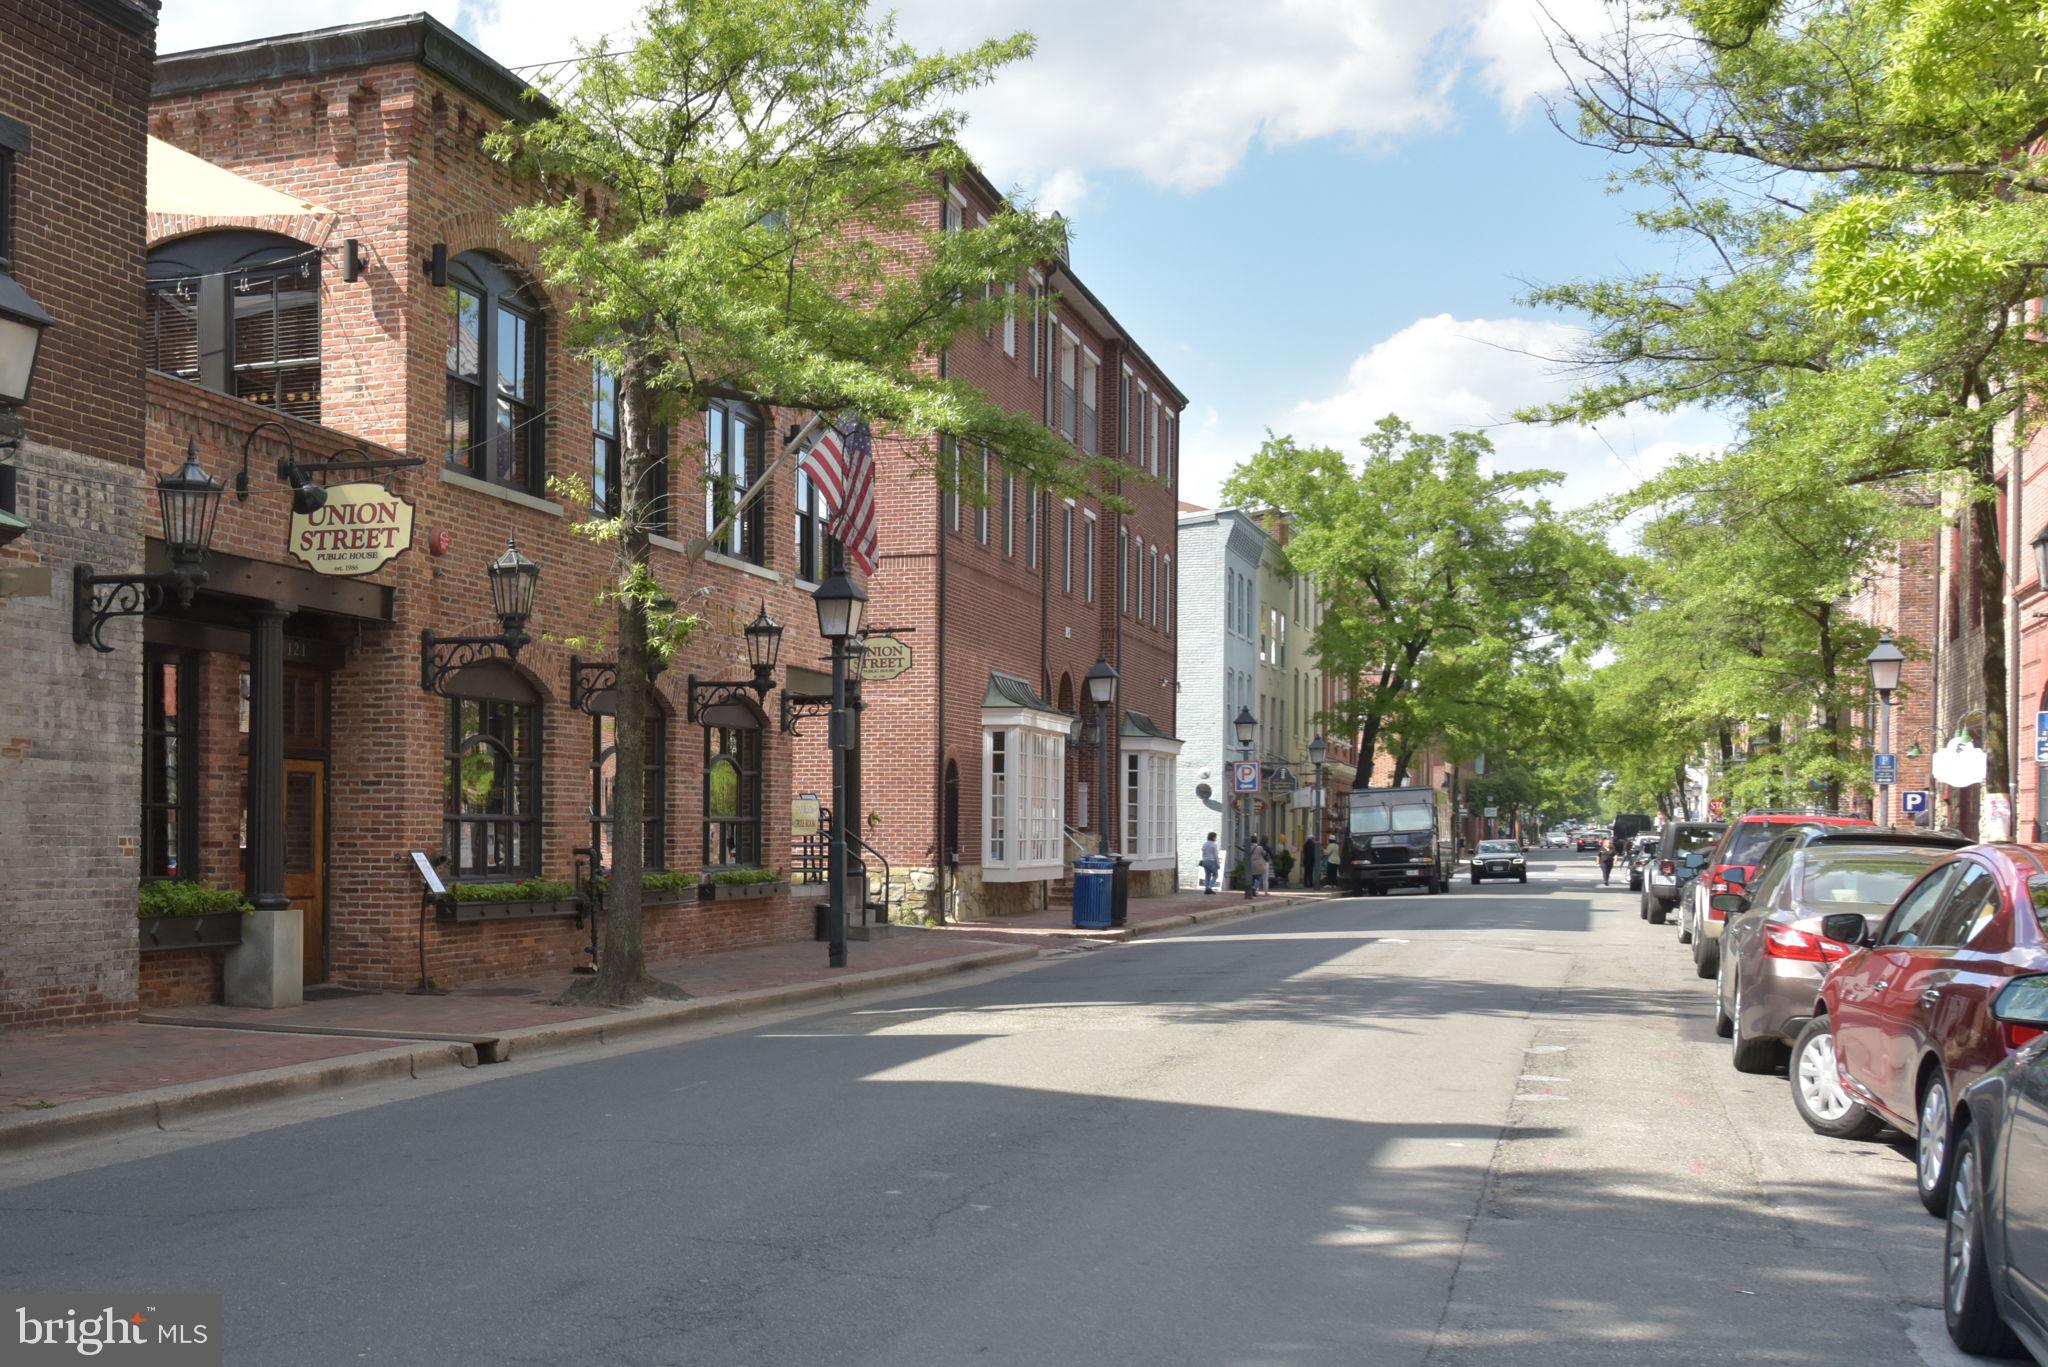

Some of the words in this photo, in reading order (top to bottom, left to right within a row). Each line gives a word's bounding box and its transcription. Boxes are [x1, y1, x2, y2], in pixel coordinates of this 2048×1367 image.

[308, 502, 399, 526] UNION
[300, 527, 400, 551] STREET
[317, 552, 348, 561] PUBLIC
[349, 551, 378, 560] HOUSE
[864, 645, 903, 657] NION
[1241, 767, 1252, 780] P
[1710, 801, 1723, 809] STO
[1906, 795, 1921, 810] P
